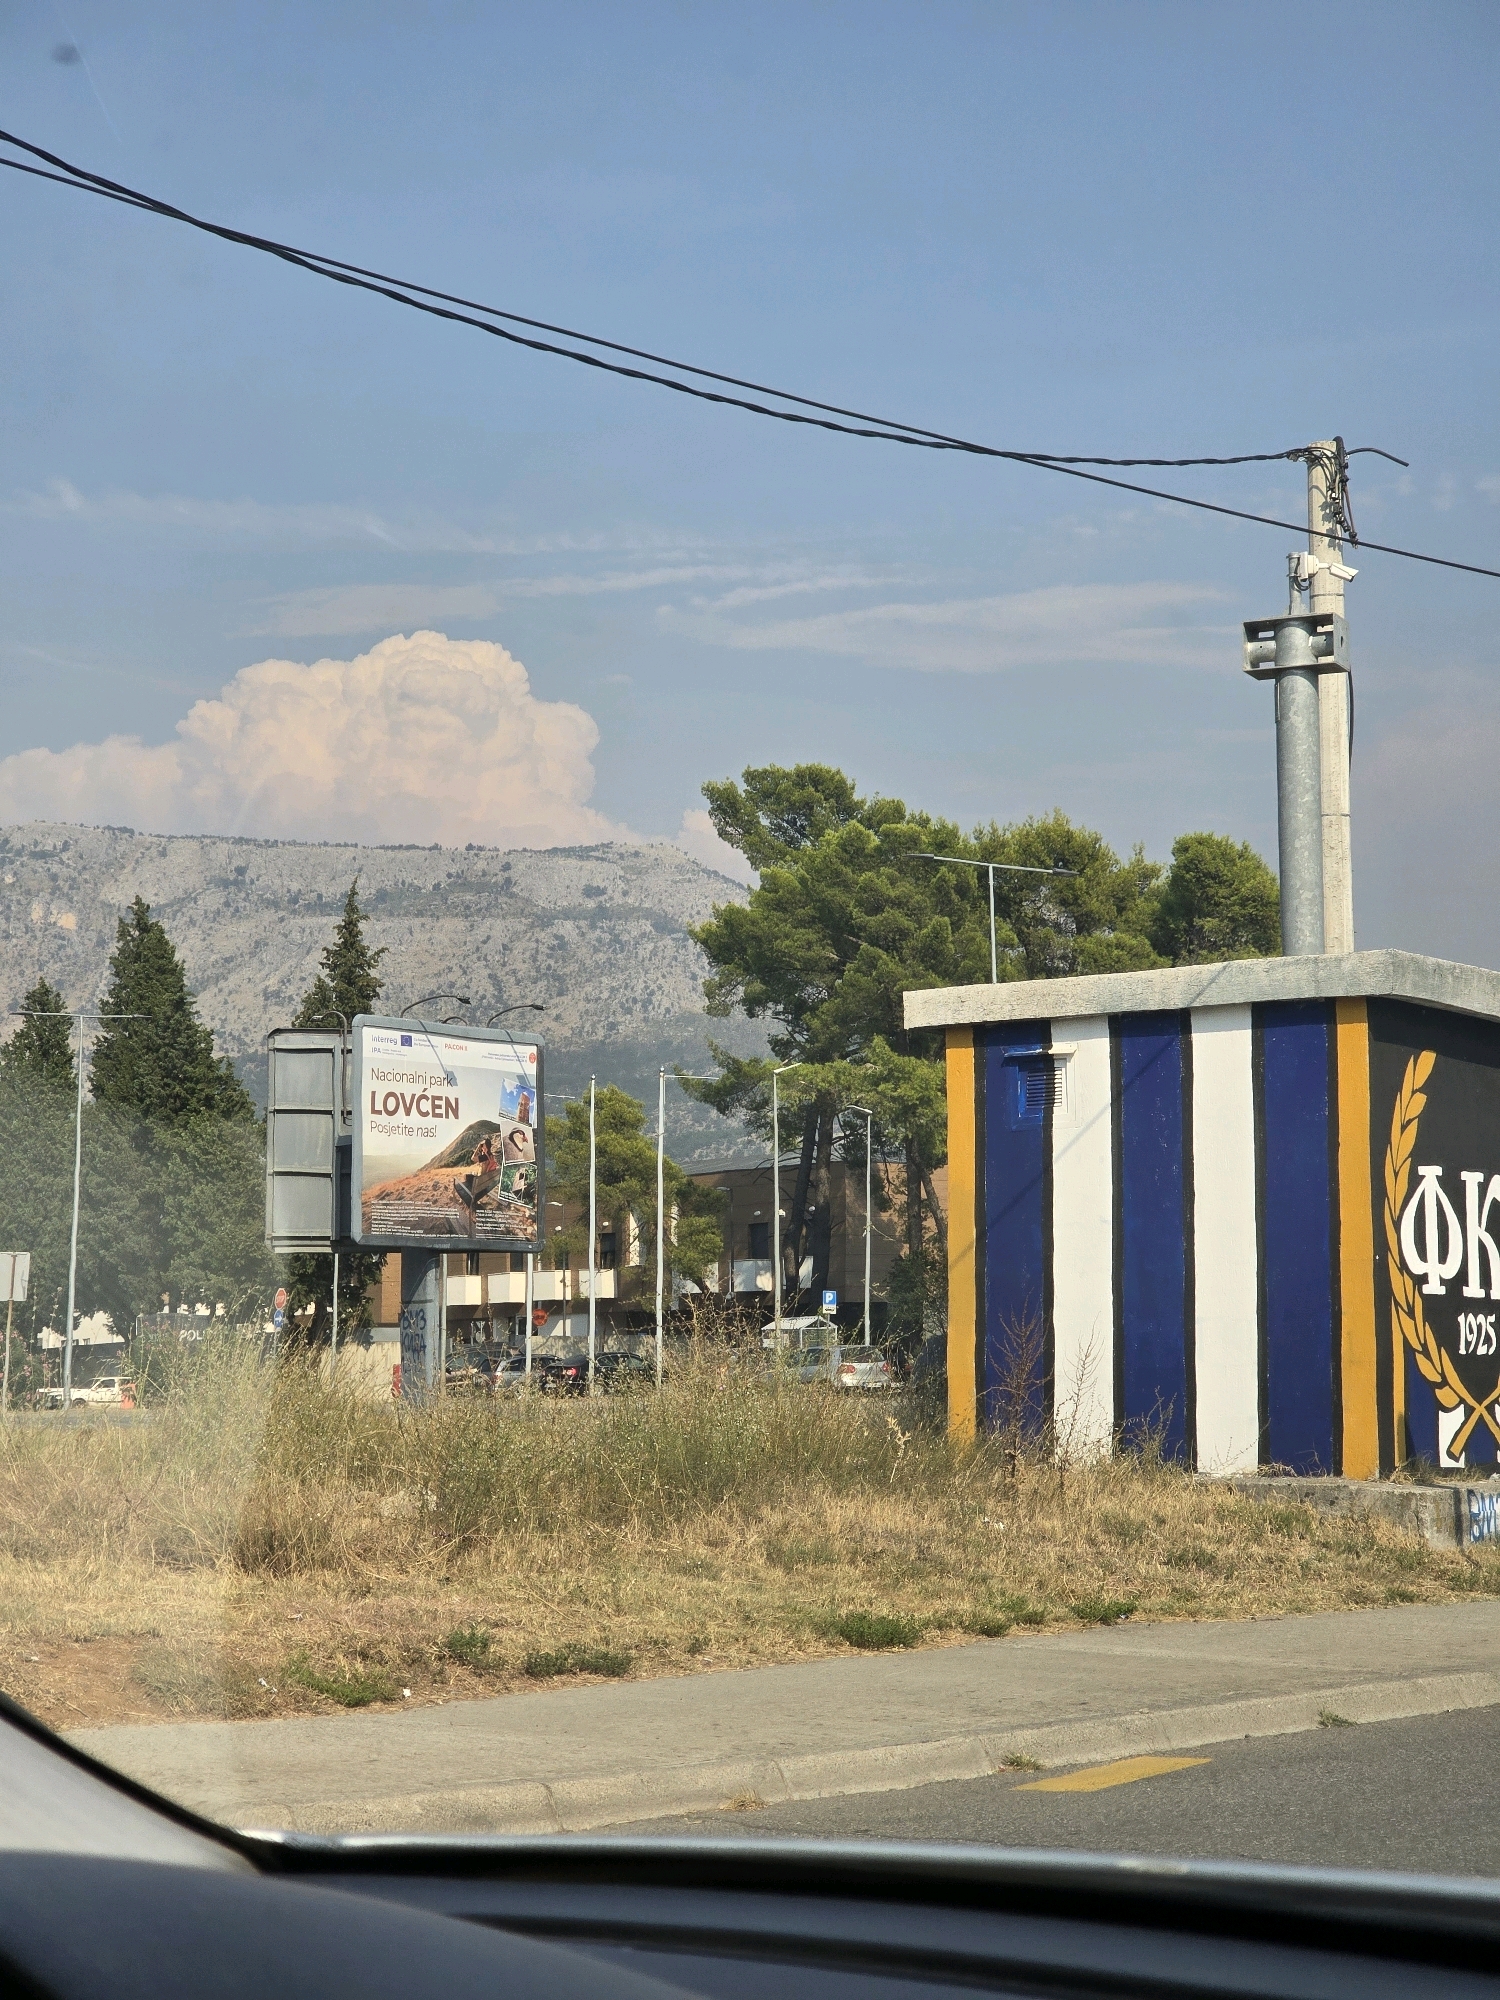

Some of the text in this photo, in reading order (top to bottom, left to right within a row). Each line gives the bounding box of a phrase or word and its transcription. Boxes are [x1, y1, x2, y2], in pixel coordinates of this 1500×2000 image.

[371, 1034, 398, 1045] Interreg
[371, 1046, 382, 1054] IPA
[371, 1067, 454, 1088] Nacionalni park
[370, 1087, 459, 1120] LOVĆEN
[370, 1120, 437, 1138] Posjetite nas!
[825, 1292, 834, 1304] P
[1457, 1311, 1497, 1356] 1925
